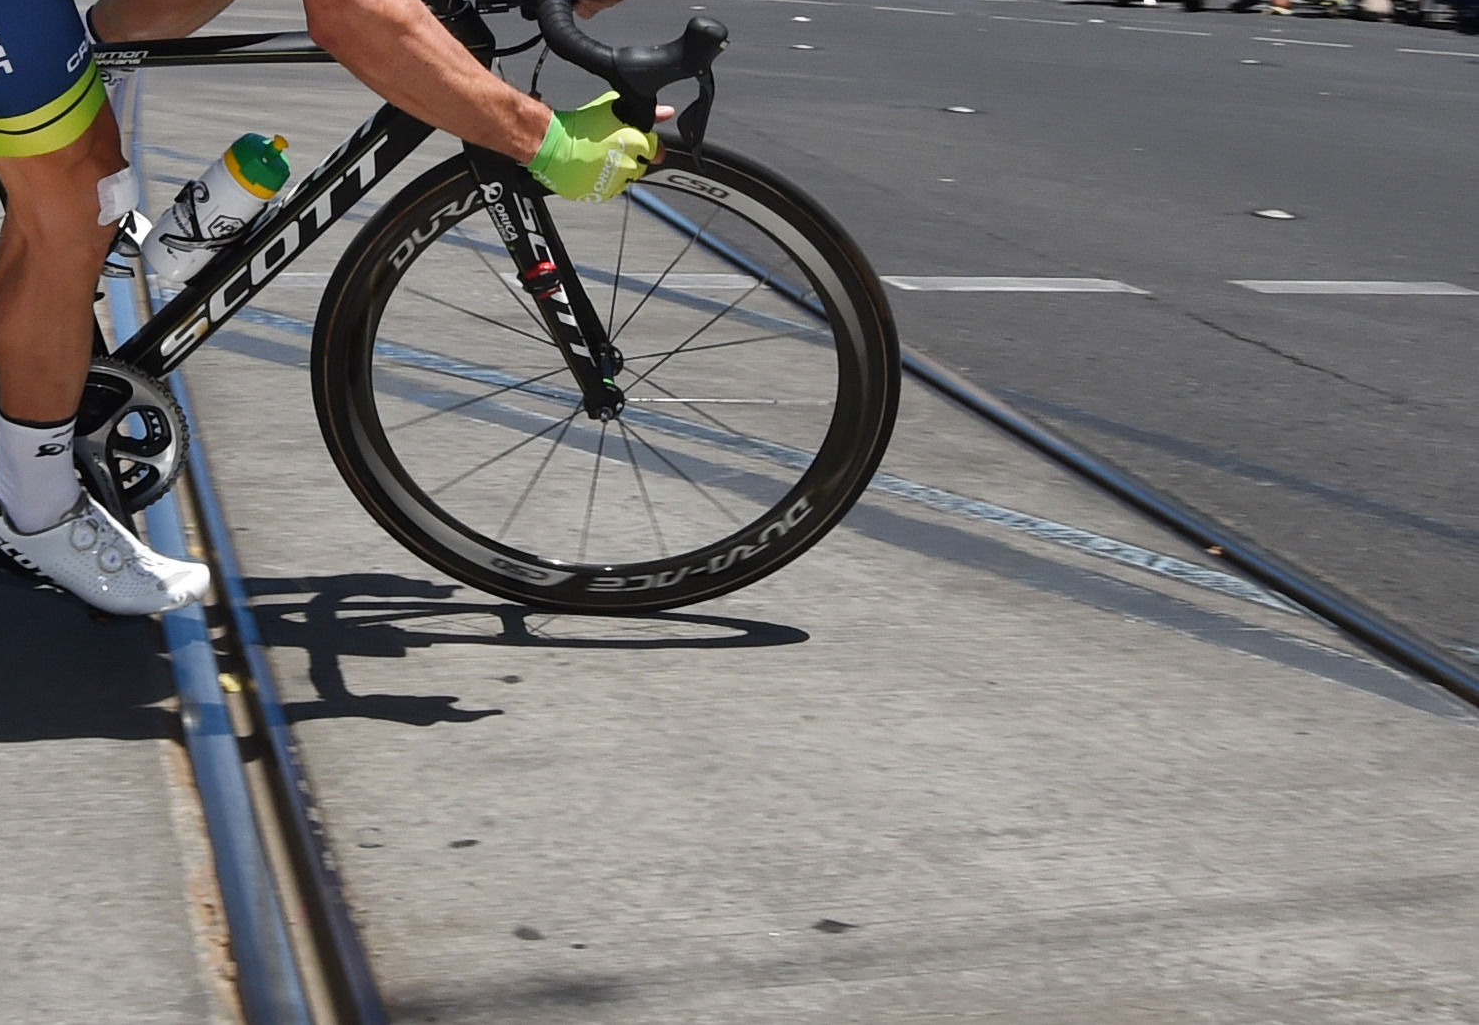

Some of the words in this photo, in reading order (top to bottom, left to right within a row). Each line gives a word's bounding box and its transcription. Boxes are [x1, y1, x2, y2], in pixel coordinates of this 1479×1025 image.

[161, 134, 389, 370] SCOTT
[494, 202, 519, 242] ORICA
[511, 191, 598, 368] SCTT
[585, 495, 815, 594] DURA-ACE
